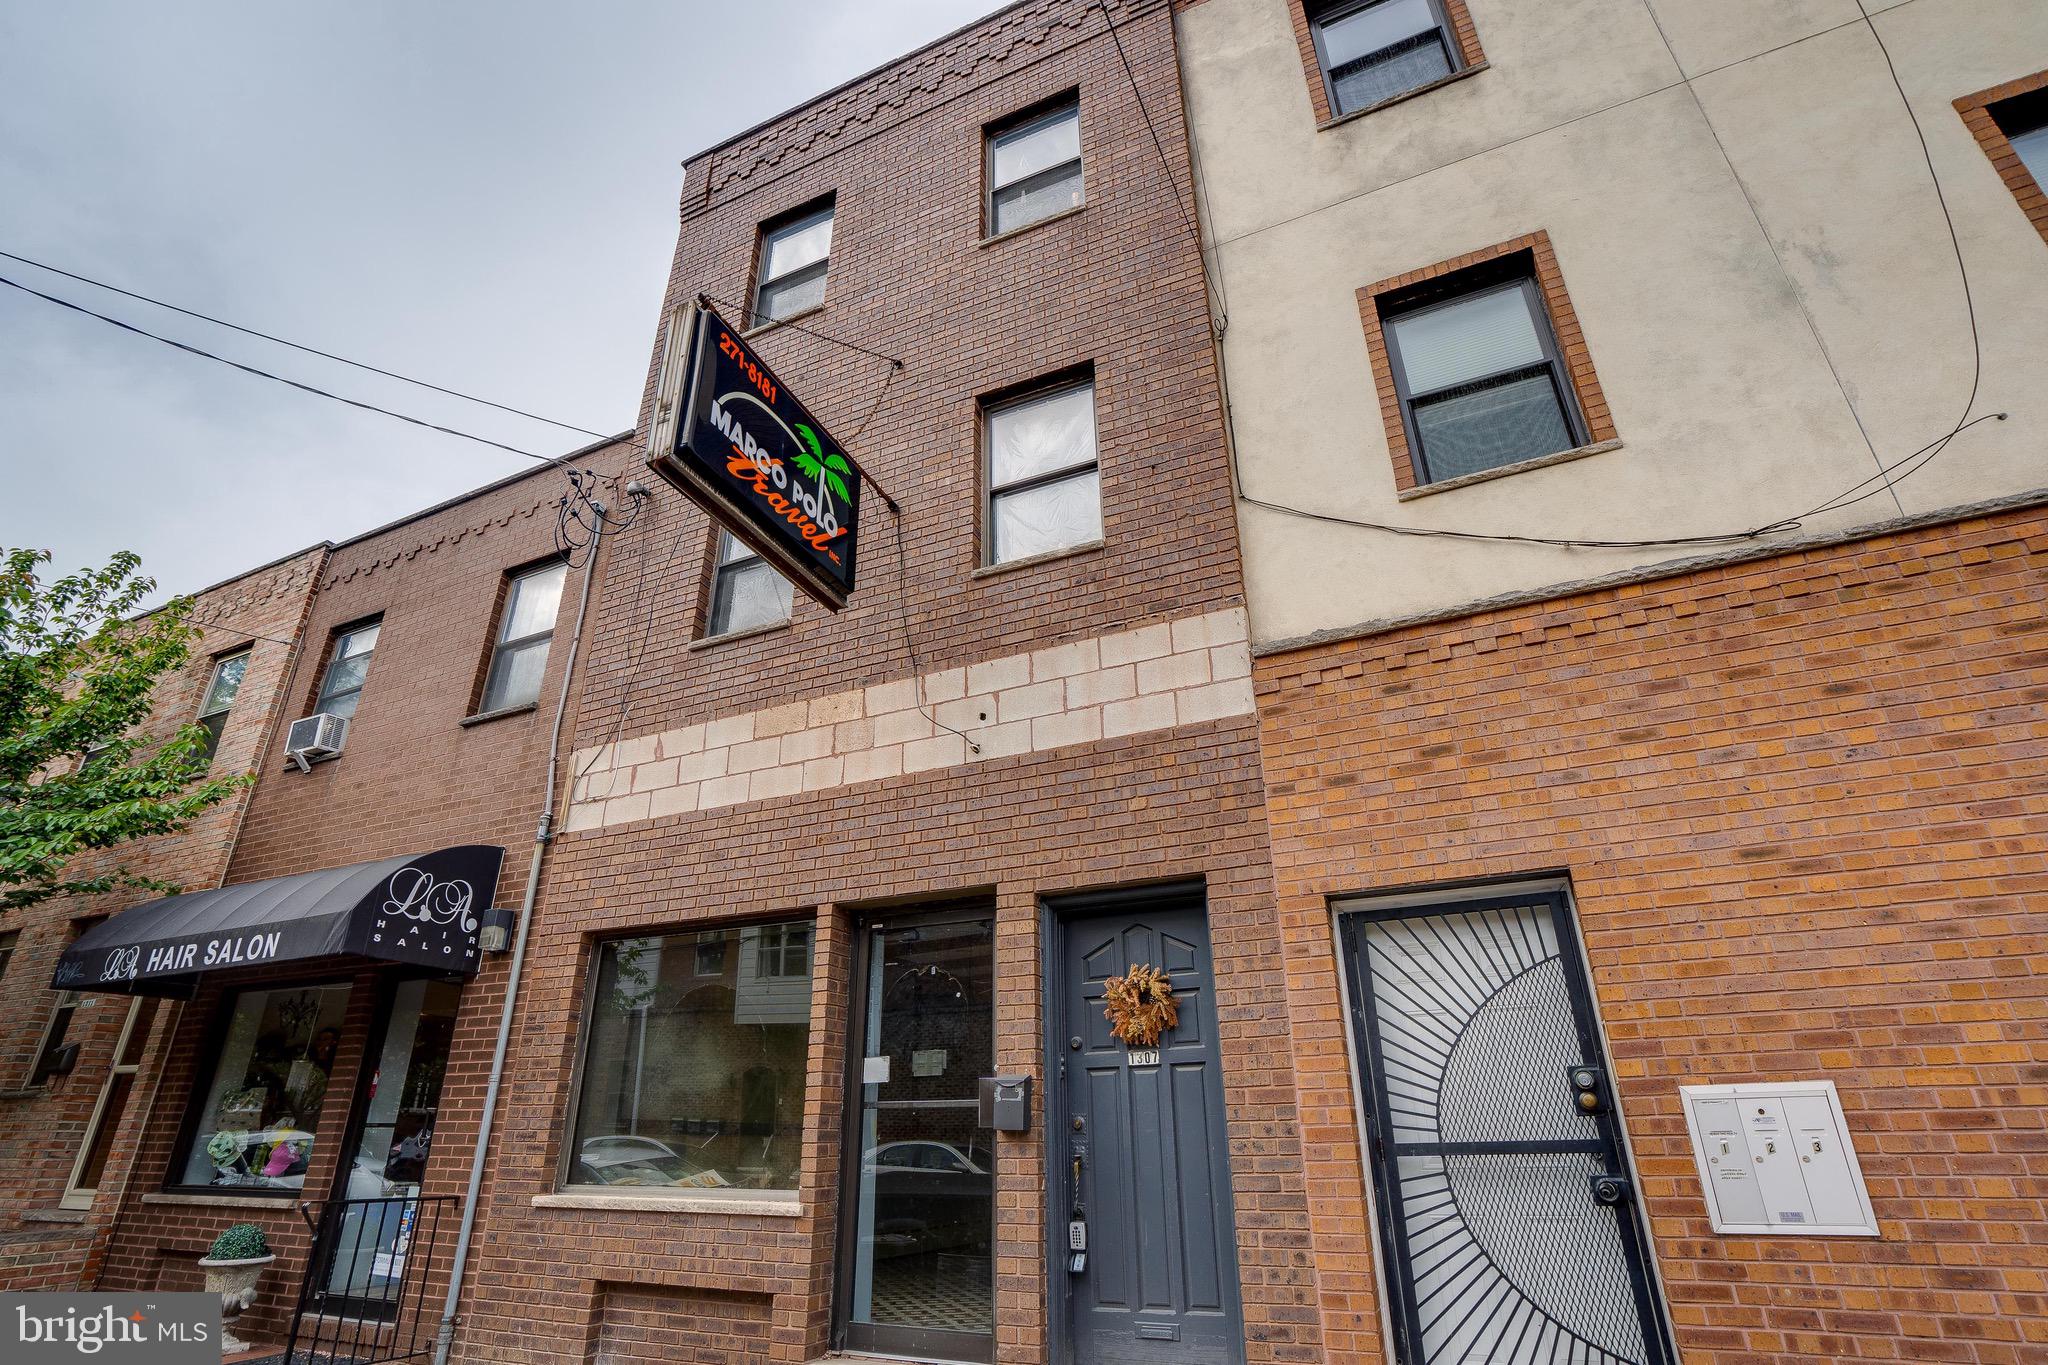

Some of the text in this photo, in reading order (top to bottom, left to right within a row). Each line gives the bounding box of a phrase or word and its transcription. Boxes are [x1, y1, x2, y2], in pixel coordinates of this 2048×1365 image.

[719, 332, 776, 404] 271-8181
[710, 400, 839, 537] MARCO POLO
[726, 445, 847, 551] Travel
[373, 933, 474, 958] SALON
[376, 919, 476, 945] HAIR
[146, 943, 198, 973] HAIR
[204, 932, 280, 966] SALON
[1130, 1051, 1158, 1065] 1307
[1767, 1142, 1775, 1153] 2
[1814, 1141, 1821, 1152] 3
